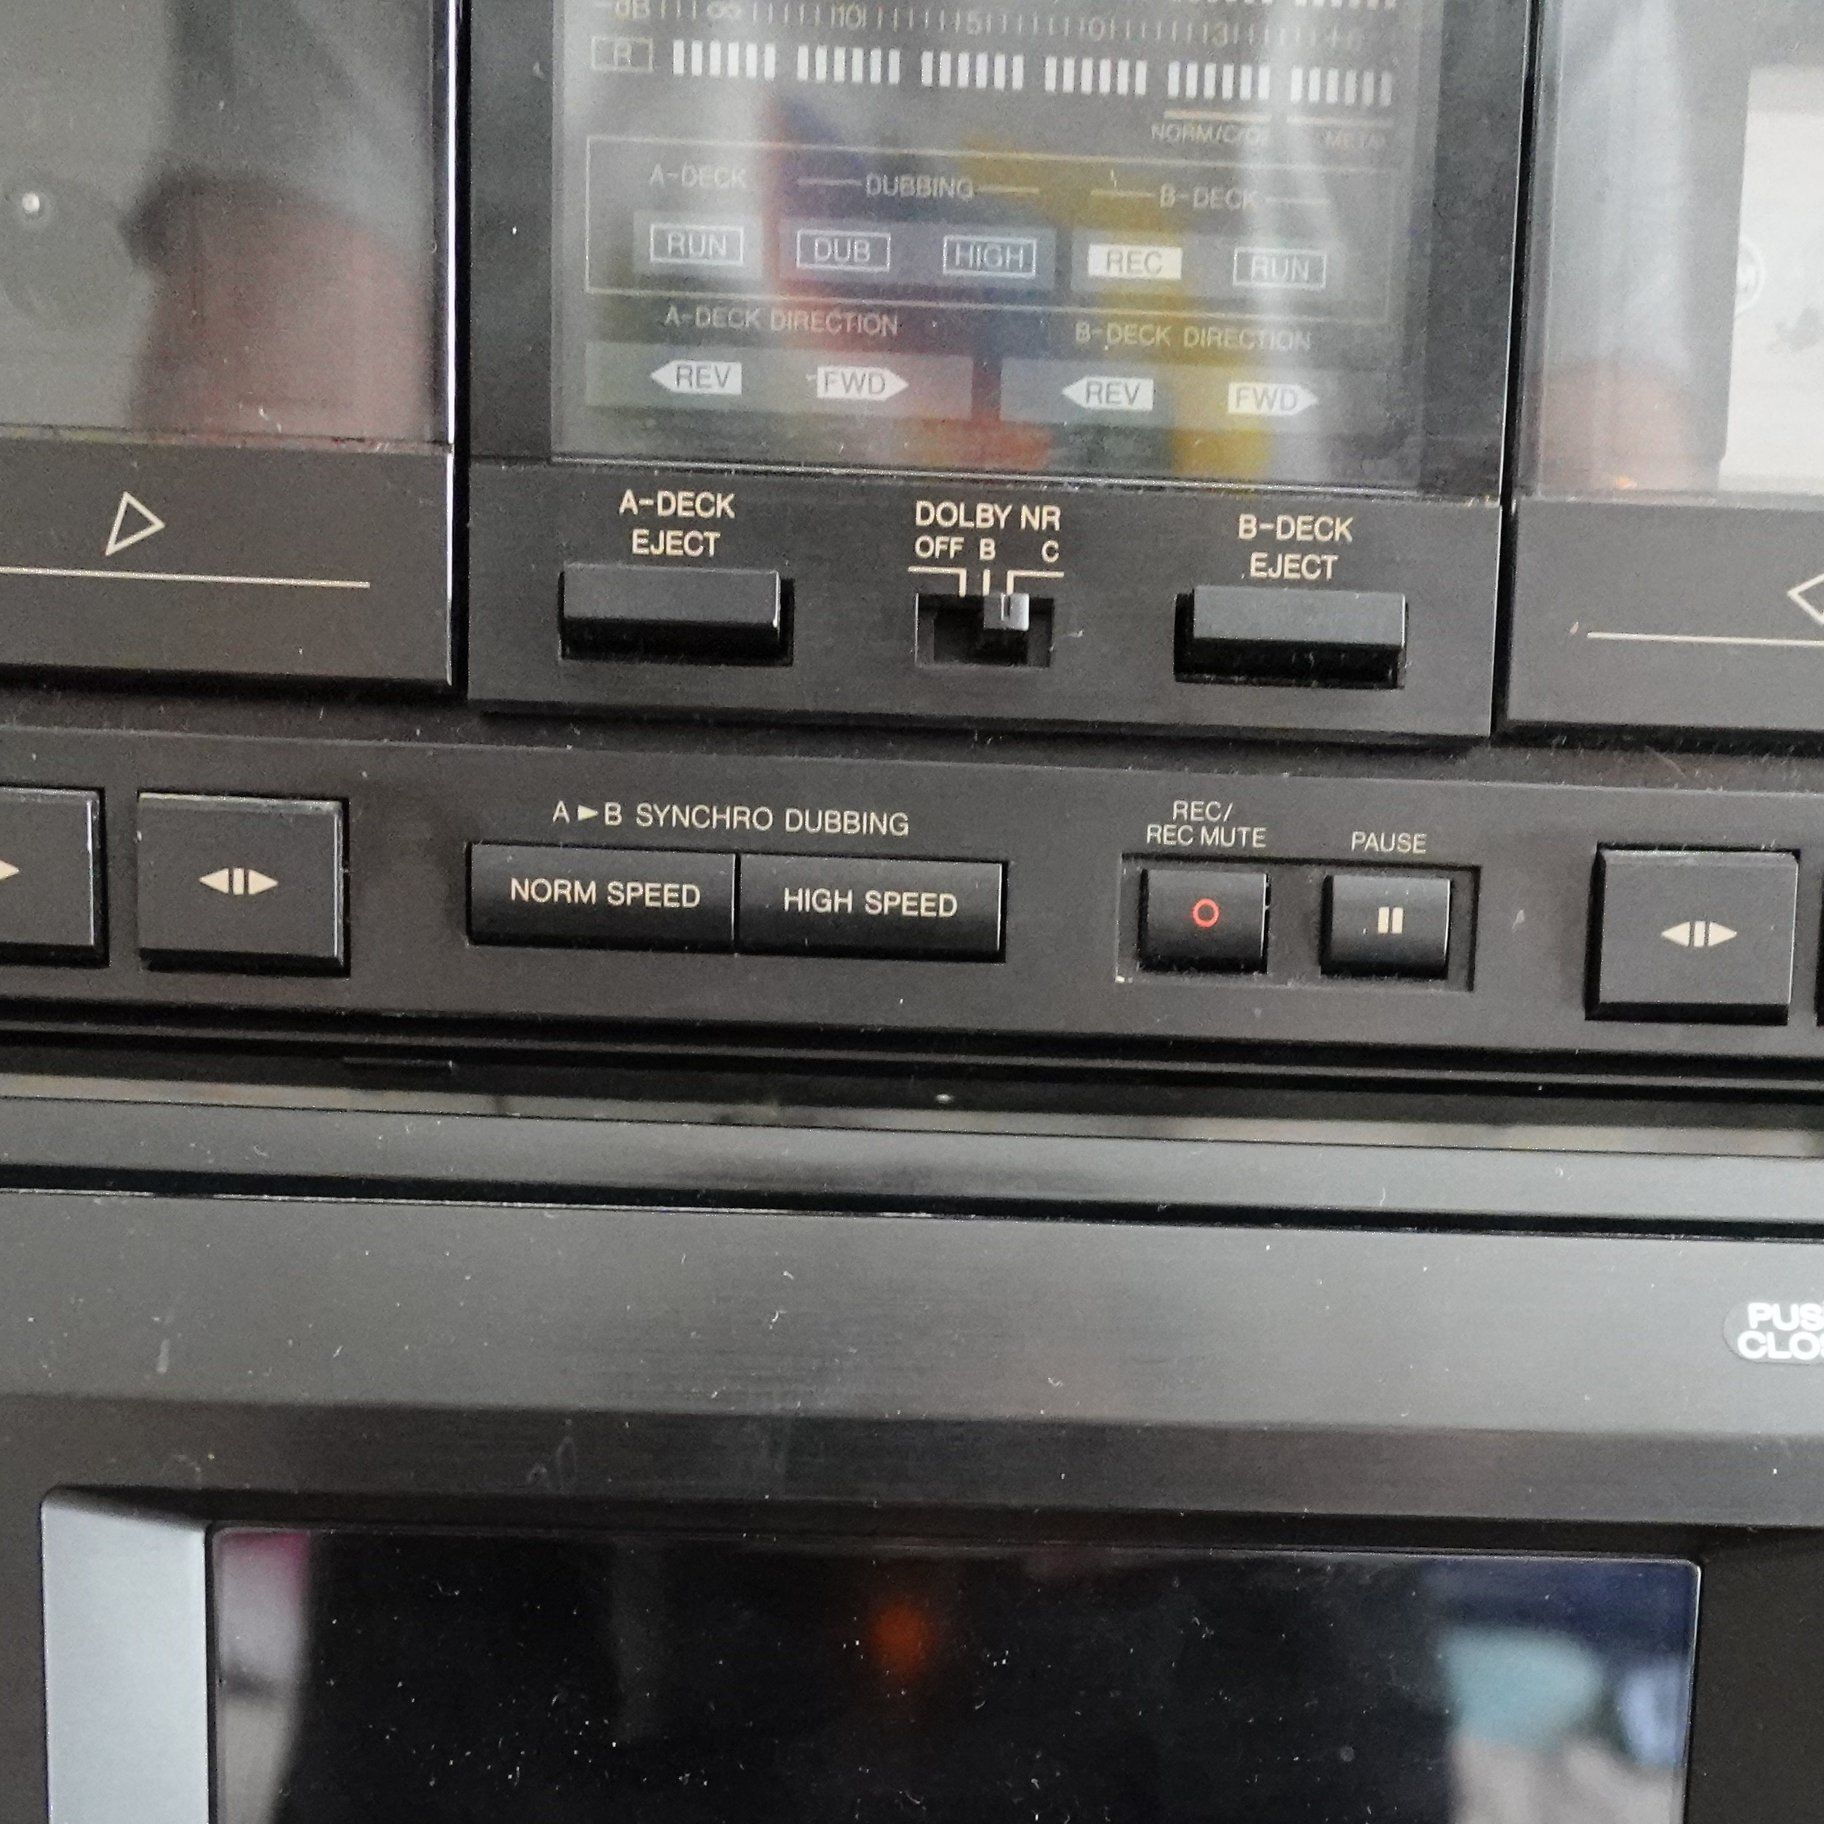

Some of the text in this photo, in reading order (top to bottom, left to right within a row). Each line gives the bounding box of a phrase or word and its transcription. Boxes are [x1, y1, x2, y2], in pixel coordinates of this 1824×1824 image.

[649, 163, 747, 189] A-DECK
[865, 173, 974, 199] DUBBING
[1160, 184, 1256, 208] B-DECK
[666, 232, 727, 258] RUN
[814, 237, 871, 263] DUB
[956, 243, 1024, 271] HIGH
[1106, 251, 1162, 272] REC
[1250, 255, 1308, 281] RUN
[664, 305, 899, 335] A-DECK DIRECTION
[1076, 322, 1310, 352] B-DECK DIRECTION
[677, 363, 729, 389] REV
[822, 370, 887, 397] FWD
[1086, 380, 1140, 405] REV
[1236, 386, 1298, 410] FWD
[619, 491, 735, 519] A-DECK
[916, 500, 1060, 532] DOLBY NR
[1239, 515, 1352, 542] B-DECK
[632, 530, 720, 557] EJECT
[914, 535, 1060, 563] OFF B C
[1251, 553, 1337, 581] EJECT
[636, 802, 773, 831] SYNCHRO
[784, 807, 909, 835] DUBBING
[1172, 801, 1234, 822] REC/
[1146, 825, 1265, 848] REC MUTE
[1351, 831, 1427, 853] PAUSE
[510, 880, 700, 908] NORM SPEED
[783, 887, 957, 917] HIGH SPEED
